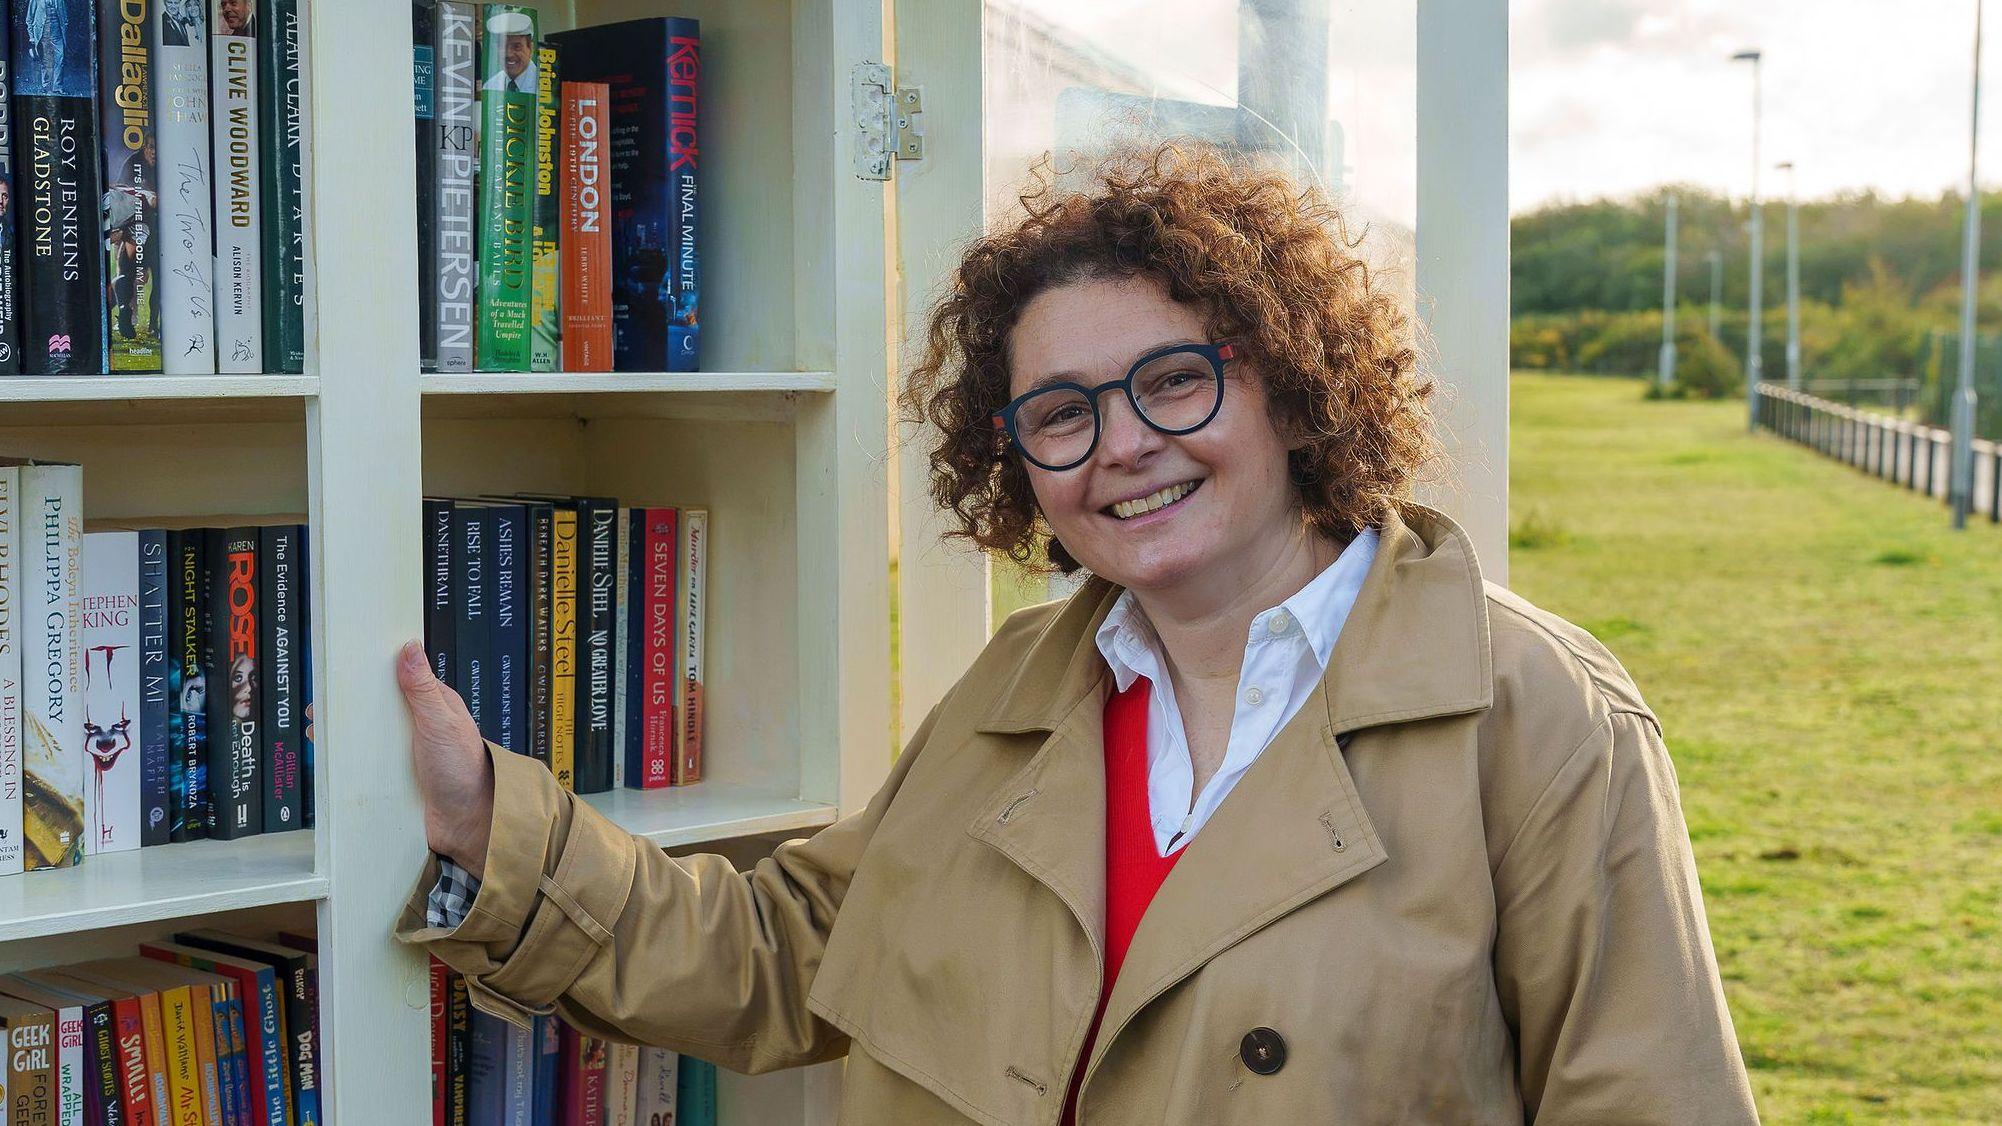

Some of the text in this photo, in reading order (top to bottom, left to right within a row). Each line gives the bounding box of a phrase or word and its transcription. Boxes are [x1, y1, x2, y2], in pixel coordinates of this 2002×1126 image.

[114, 0, 149, 150] Dallaglio
[286, 12, 300, 148] ALAN CLARK
[442, 14, 472, 122] KEVIN
[227, 42, 251, 228] CLIVE WOODWARD
[538, 49, 557, 196] Brian Johnston
[667, 36, 700, 172] Kernick
[440, 125, 473, 151] KP
[579, 99, 601, 233] LONDON
[33, 117, 52, 257] GLADSTONE
[58, 118, 79, 282] ROY JENKINS
[133, 164, 143, 184] IT'S
[504, 102, 528, 290] DICKIE BIRD
[134, 198, 144, 220] THE
[494, 203, 502, 232] AND
[681, 176, 695, 291] FINAL MINUTE
[135, 224, 145, 264] BLOOD:
[136, 267, 145, 282] MY
[441, 154, 472, 348] PIETERSEN
[493, 242, 501, 287] BAILS
[3, 265, 13, 321] Autobiography
[136, 285, 146, 305] LIFE
[232, 246, 243, 315] ALISON KERVIN
[581, 276, 589, 304] WHITE
[66, 548, 81, 597] Boleyn
[228, 540, 255, 553] KAREN
[437, 511, 450, 610] DANETHRALL
[467, 522, 482, 621] RISE TO FALL
[499, 517, 513, 627] ASHES REMAIN
[592, 509, 614, 618] DANIELLE STEEL
[44, 496, 65, 723] PHILIPPA GREGORY
[83, 594, 137, 611] TEPHEN
[184, 553, 198, 676] NIGHT STALKER
[227, 552, 256, 662] ROSE
[538, 518, 549, 652] BENEATH DARK WATERS
[556, 520, 576, 678] Danielle Steel
[68, 603, 81, 693] Inheritance
[83, 611, 129, 629] KING
[144, 543, 164, 709] SHATTER ME
[276, 536, 290, 728] The Evidence AGAINST YOU
[652, 542, 668, 706] SEVEN DAYS OF US
[85, 645, 132, 691] IT
[502, 654, 511, 714] GWENDOLINE
[587, 629, 608, 732] NO GREATER LOVE
[688, 666, 698, 693] TOM
[4, 696, 17, 776] BLESSING
[188, 715, 198, 754] ROBERT
[536, 664, 547, 755] GWEN MARSH
[556, 693, 565, 764] HIGH NOTES
[657, 710, 668, 756] Francesca
[231, 741, 242, 799] Enough
[241, 721, 256, 792] Death is
[273, 741, 285, 800] McAllister
[285, 751, 297, 787] Gillian
[5, 782, 17, 801] IN
[12, 1024, 50, 1048] GEEK
[61, 1020, 84, 1035] GEEK
[174, 1002, 186, 1033] David
[262, 984, 284, 1126] The Little Ghost
[297, 1030, 315, 1092] DOG MAN
[33, 1073, 48, 1126] FORE
[61, 1064, 73, 1126] WRAPPED
[73, 1092, 83, 1117] ALL
[180, 1086, 195, 1109] Mr
[452, 1073, 465, 1126] VAMPIRE
